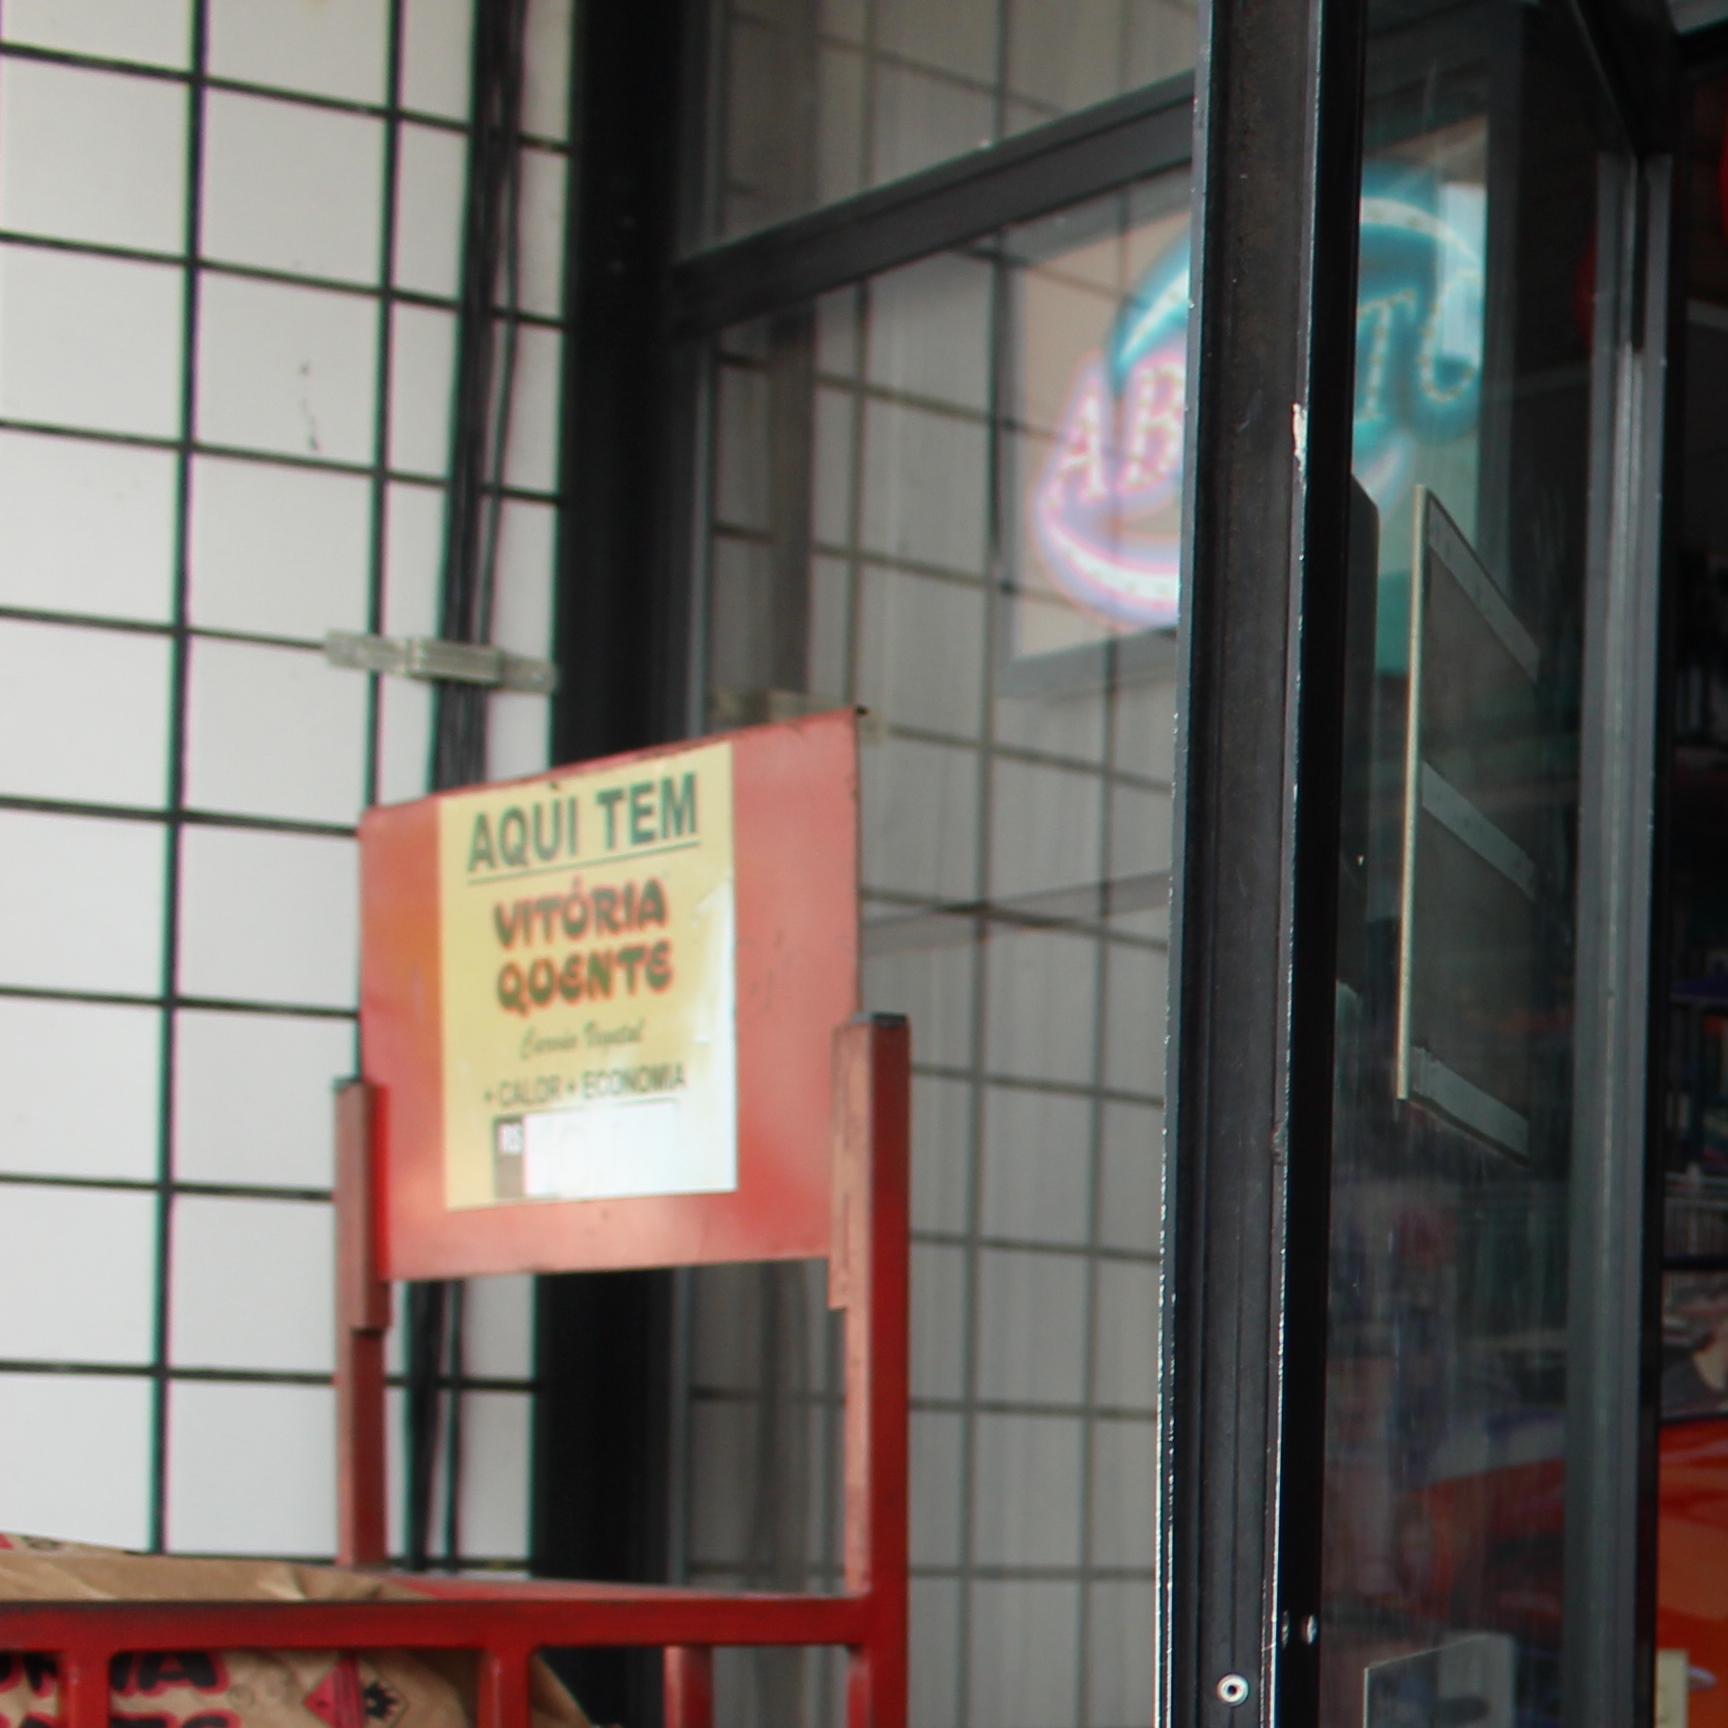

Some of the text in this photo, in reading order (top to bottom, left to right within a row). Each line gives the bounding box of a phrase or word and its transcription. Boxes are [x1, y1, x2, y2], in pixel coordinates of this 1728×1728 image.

[467, 772, 699, 874] AQUI TEM
[494, 876, 667, 950] VITÓRIA
[582, 1063, 687, 1100] ECONOMIA
